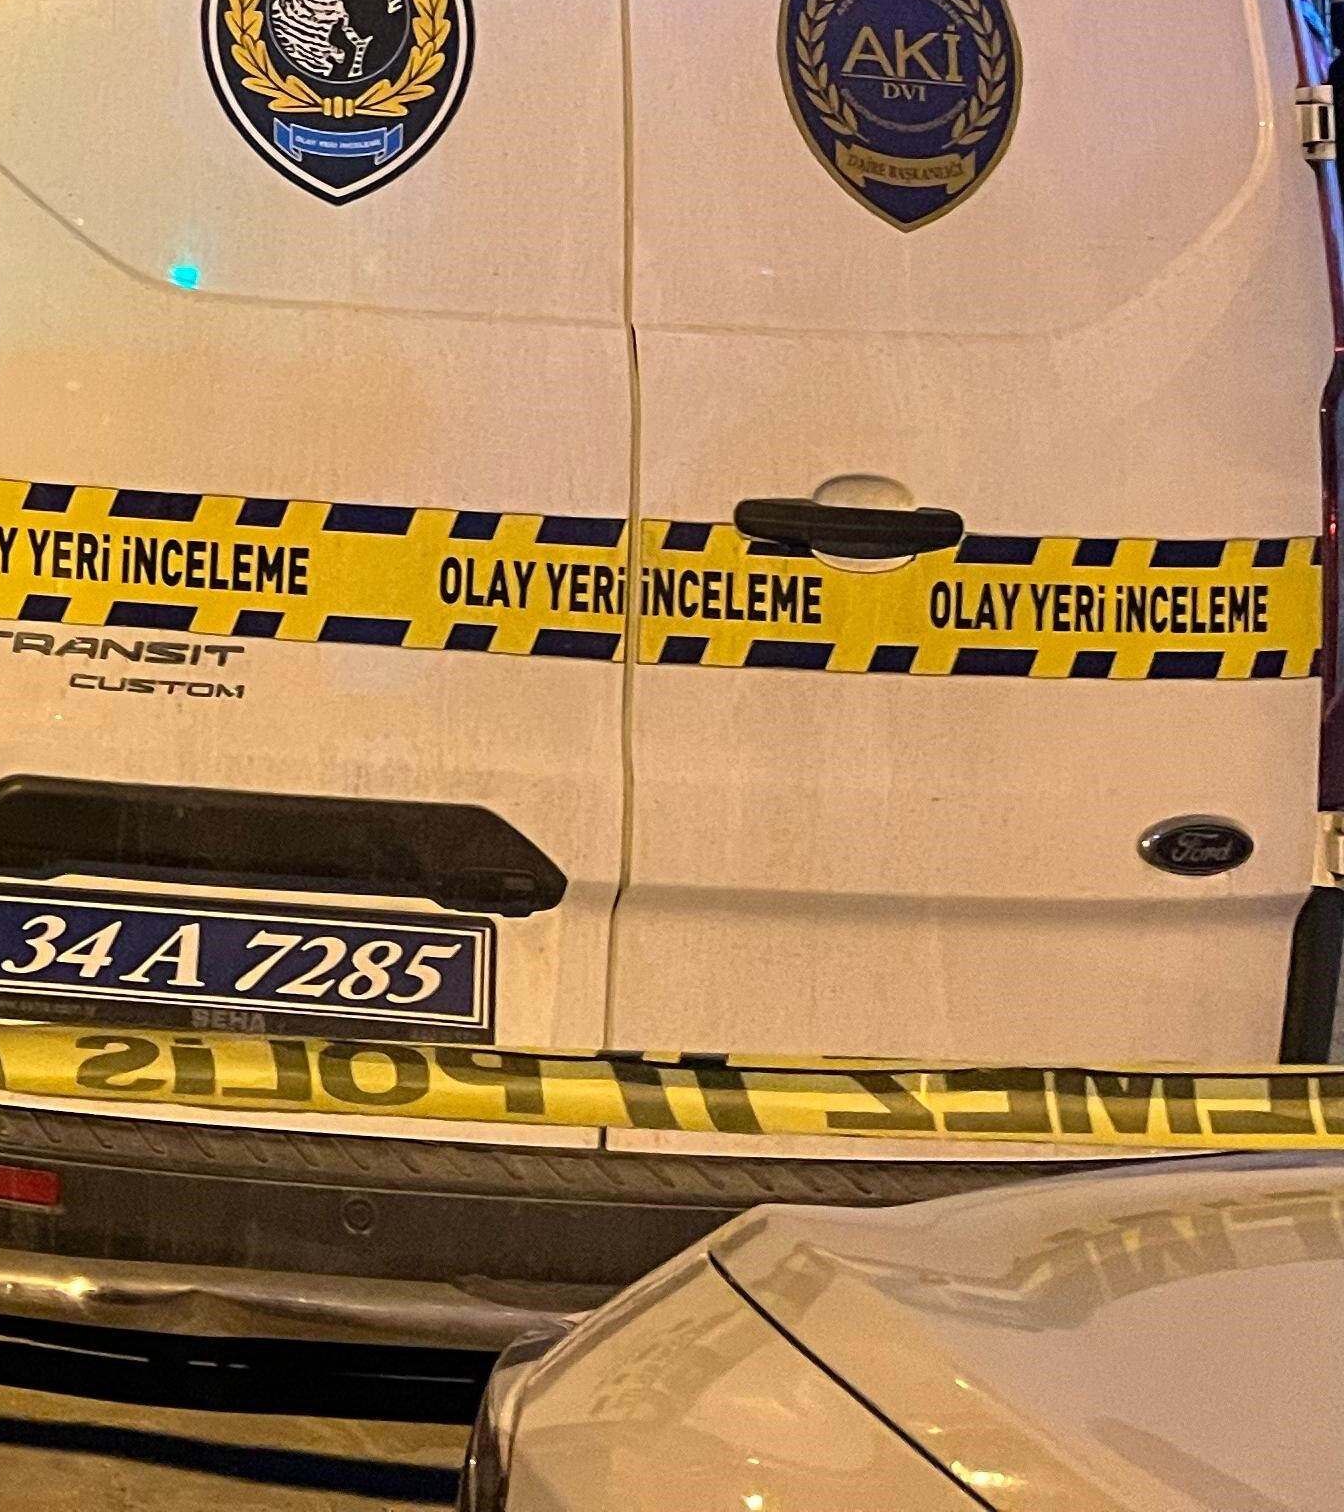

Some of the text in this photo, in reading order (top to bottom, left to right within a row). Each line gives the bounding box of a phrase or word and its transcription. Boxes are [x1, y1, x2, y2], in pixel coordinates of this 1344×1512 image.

[439, 557, 538, 610] OLAY
[930, 580, 1021, 631] OLAY
[68, 673, 245, 700] CUSTOM
[0, 914, 463, 1005] 34 A 7285
